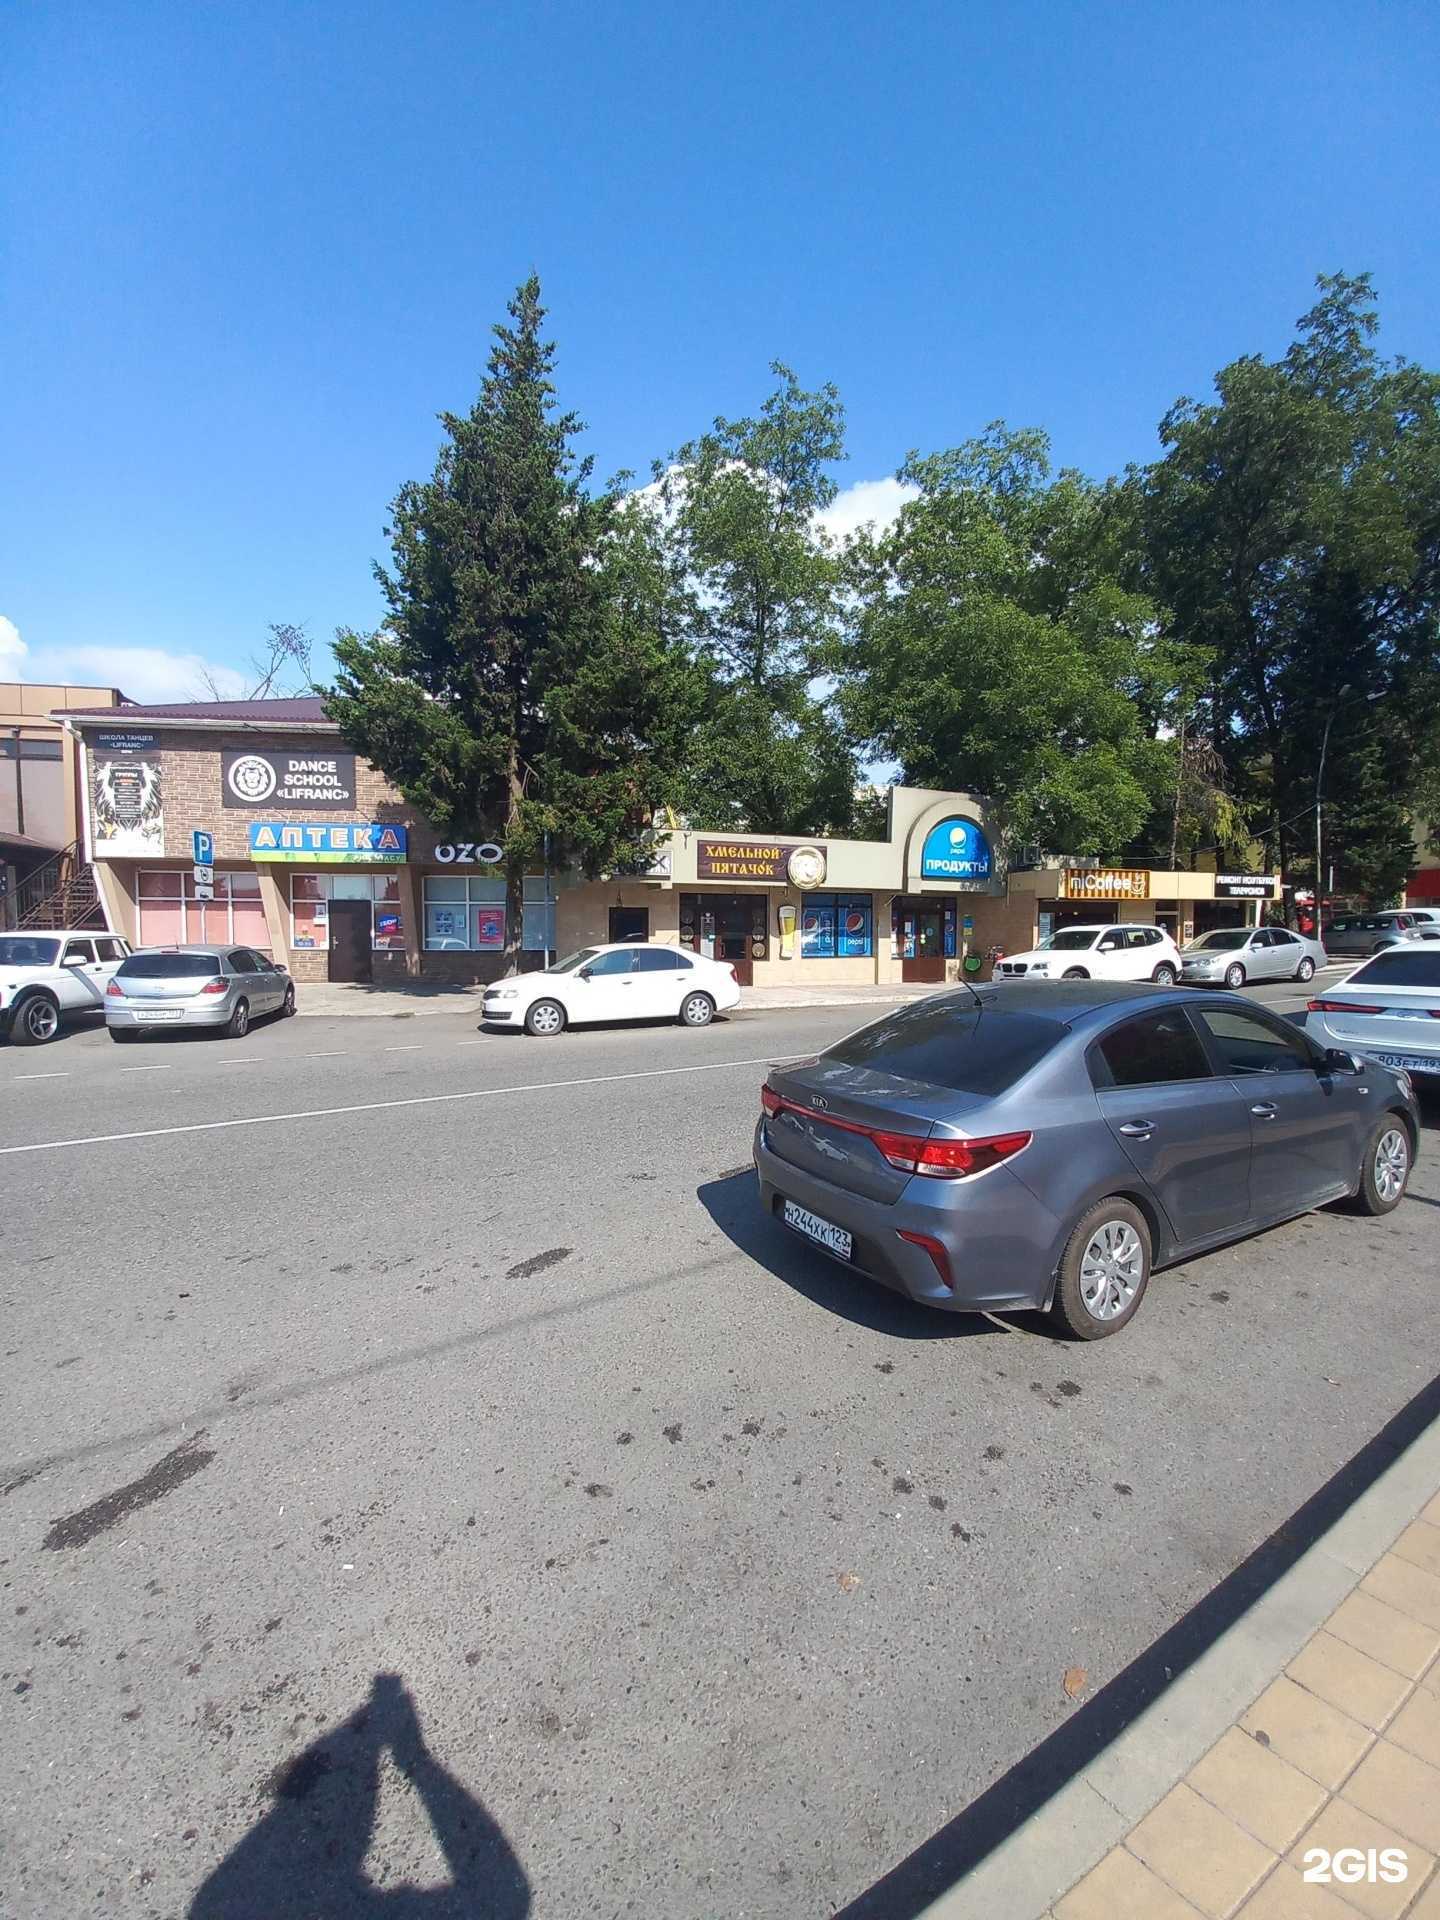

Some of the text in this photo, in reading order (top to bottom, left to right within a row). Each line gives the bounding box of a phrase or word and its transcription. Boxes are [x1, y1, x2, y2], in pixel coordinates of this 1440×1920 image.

[127, 734, 154, 742] ТАНЦЕВ
[288, 760, 336, 772] DANCE
[284, 775, 342, 786] SCHOOL
[276, 788, 349, 800] «LIFRANC»
[255, 827, 400, 849] АПТЕКА
[198, 834, 210, 861] P
[435, 843, 503, 863] OZO
[706, 846, 781, 859] ХМЕЛЬНОЙ
[926, 859, 988, 873] ПРОДУКТЫ
[1216, 876, 1275, 885] РЕМОНТ НОУТБУКО
[848, 938, 864, 946] pepsi
[1378, 1055, 1419, 1068] 903ЕТ
[830, 1227, 849, 1247] 123
